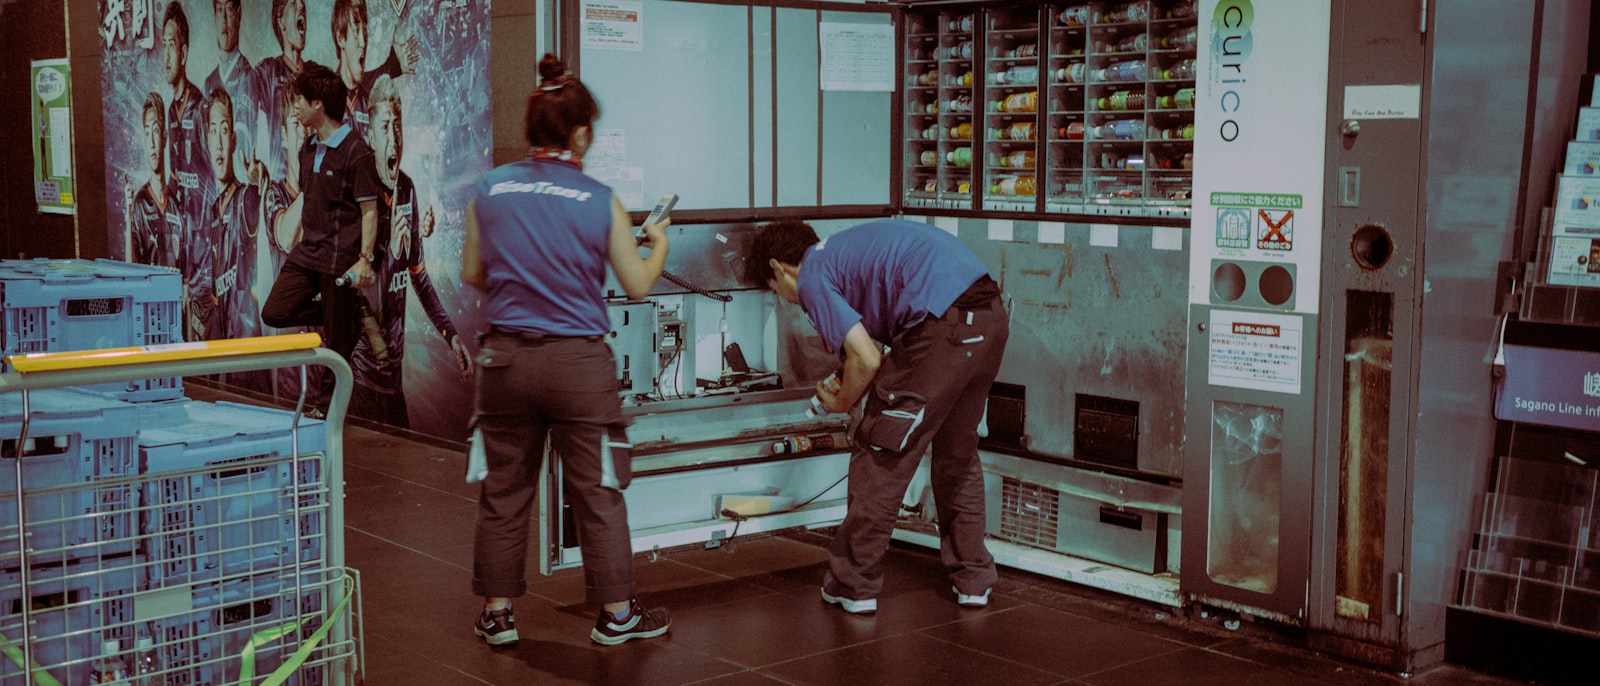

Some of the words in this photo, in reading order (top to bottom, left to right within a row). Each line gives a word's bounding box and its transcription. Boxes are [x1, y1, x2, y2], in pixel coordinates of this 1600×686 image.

[1220, 6, 1246, 142] curico
[1212, 194, 1300, 206] 分別回収にご協力ください
[1234, 325, 1278, 335] お客様へのお願い
[1515, 396, 1556, 412] Sagano
[1559, 402, 1582, 416] Line
